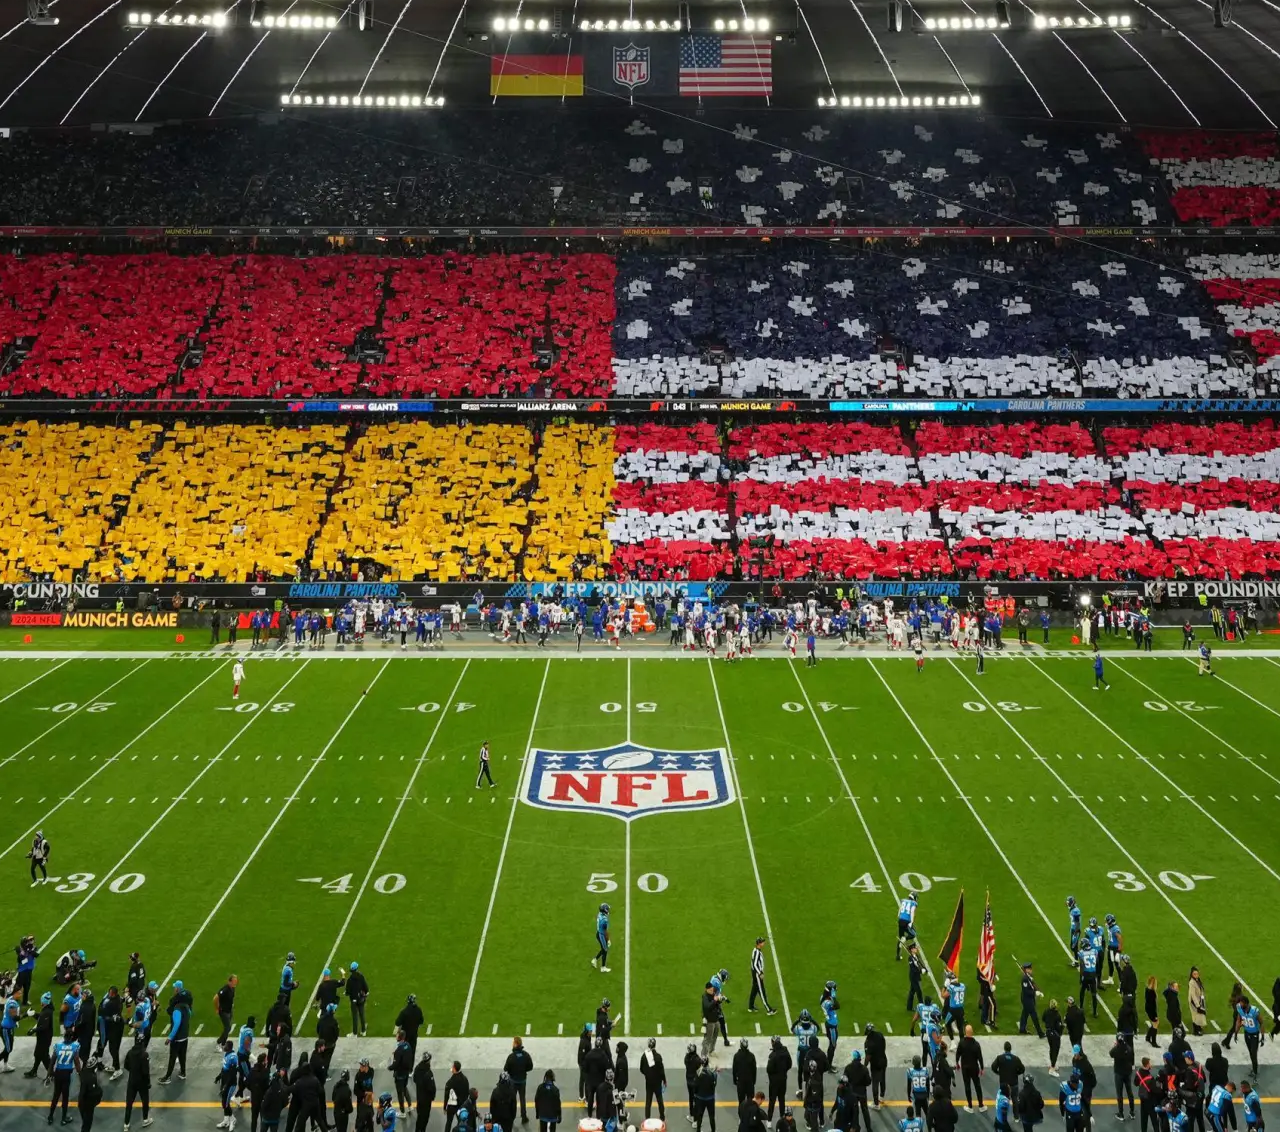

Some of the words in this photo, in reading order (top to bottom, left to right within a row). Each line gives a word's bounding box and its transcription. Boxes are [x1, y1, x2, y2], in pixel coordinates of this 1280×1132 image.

[616, 62, 646, 83] NFL
[367, 403, 399, 411] GIANTS
[1007, 400, 1045, 410] CAROLINA
[1046, 400, 1086, 411] PANTHERS
[288, 584, 341, 597] CAROLINA
[344, 584, 399, 597] PANTHERS
[1144, 583, 1190, 597] KEP
[17, 615, 37, 624] 2024
[39, 615, 56, 624] NFL
[63, 612, 131, 627] MUNICH
[131, 612, 178, 627] GAME
[547, 771, 710, 808] NFL
[55, 872, 147, 893] 30
[320, 872, 408, 894] 40
[586, 872, 670, 893] 50
[849, 872, 933, 893] 40
[1106, 870, 1197, 892] 30
[58, 1050, 73, 1064] 77
